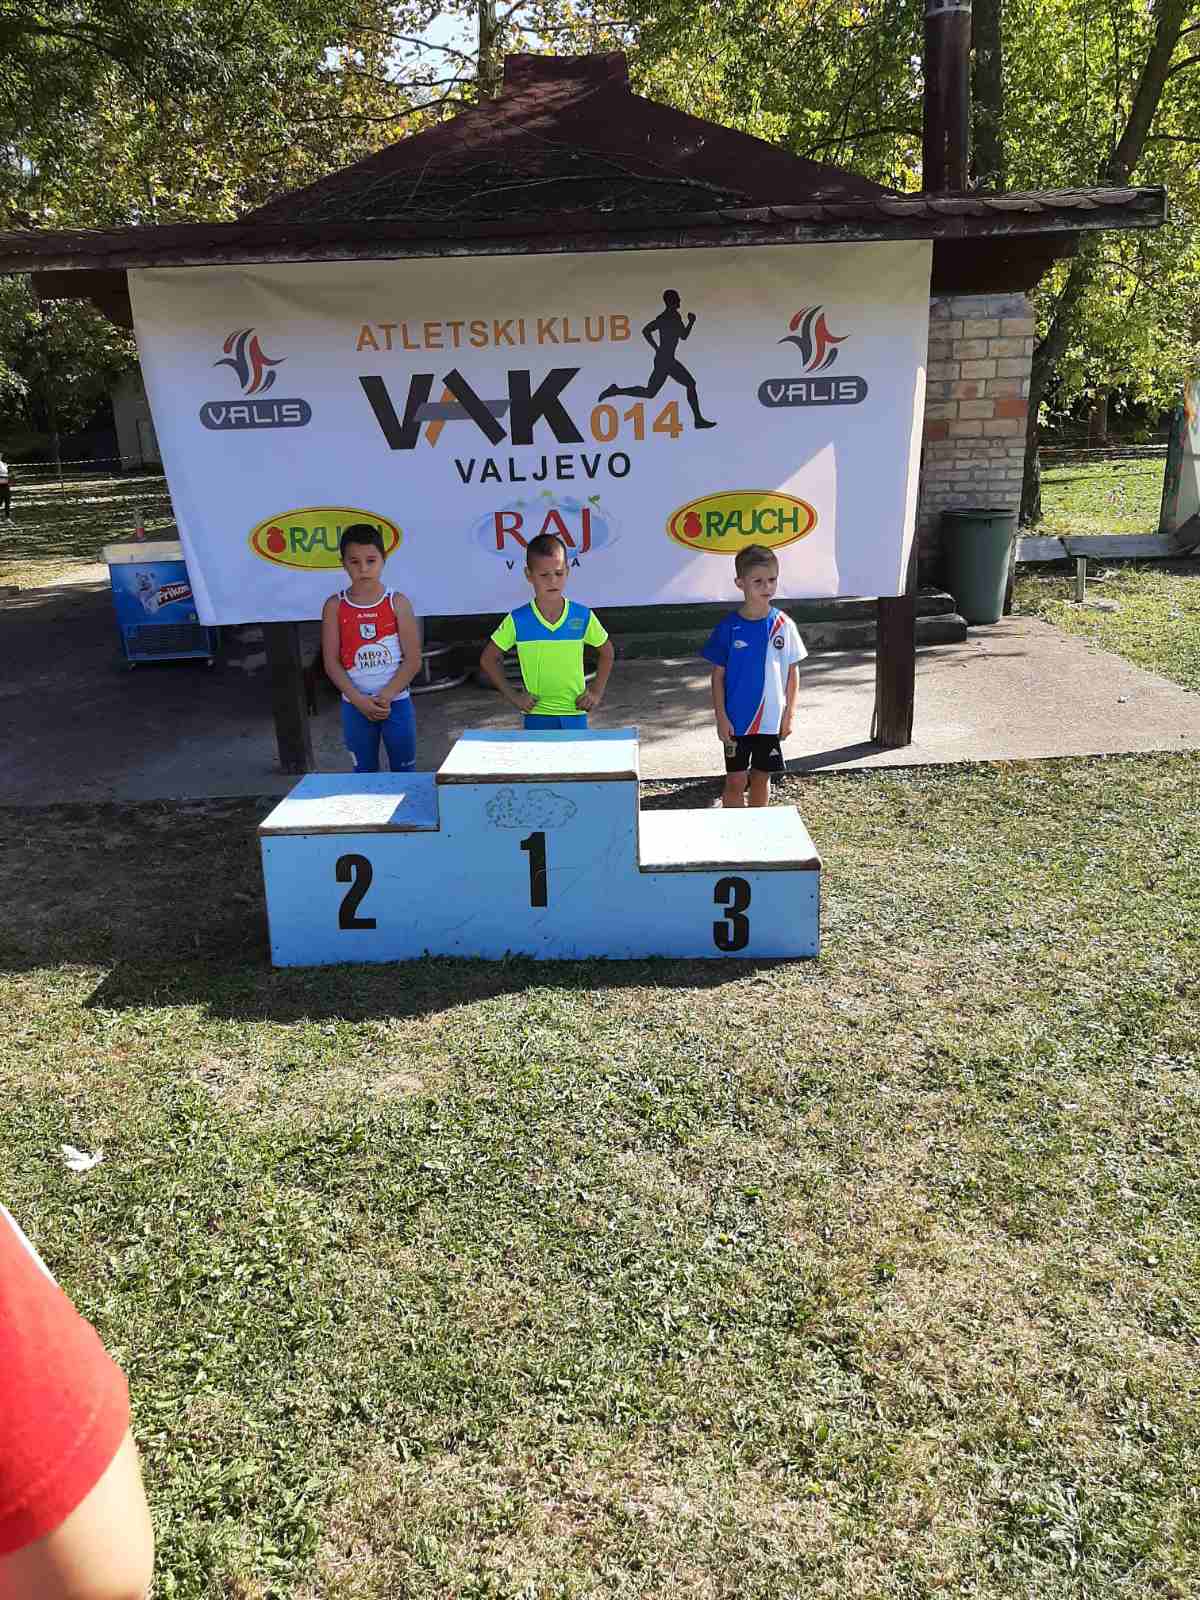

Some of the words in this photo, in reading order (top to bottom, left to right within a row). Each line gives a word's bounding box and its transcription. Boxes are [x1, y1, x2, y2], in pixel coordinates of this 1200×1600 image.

[355, 319, 526, 351] ATLETSKI
[537, 315, 632, 344] KLUB
[358, 367, 585, 450] VAK
[590, 400, 684, 442] 014
[766, 382, 858, 402] VALIS
[207, 404, 302, 425] VALIS
[454, 452, 632, 484] VALJEVO
[289, 524, 383, 554] RAU
[494, 506, 592, 554] RAJ
[705, 507, 799, 538] RAUCH
[519, 831, 548, 908] 1
[335, 853, 377, 930] 2
[712, 876, 751, 952] 3
